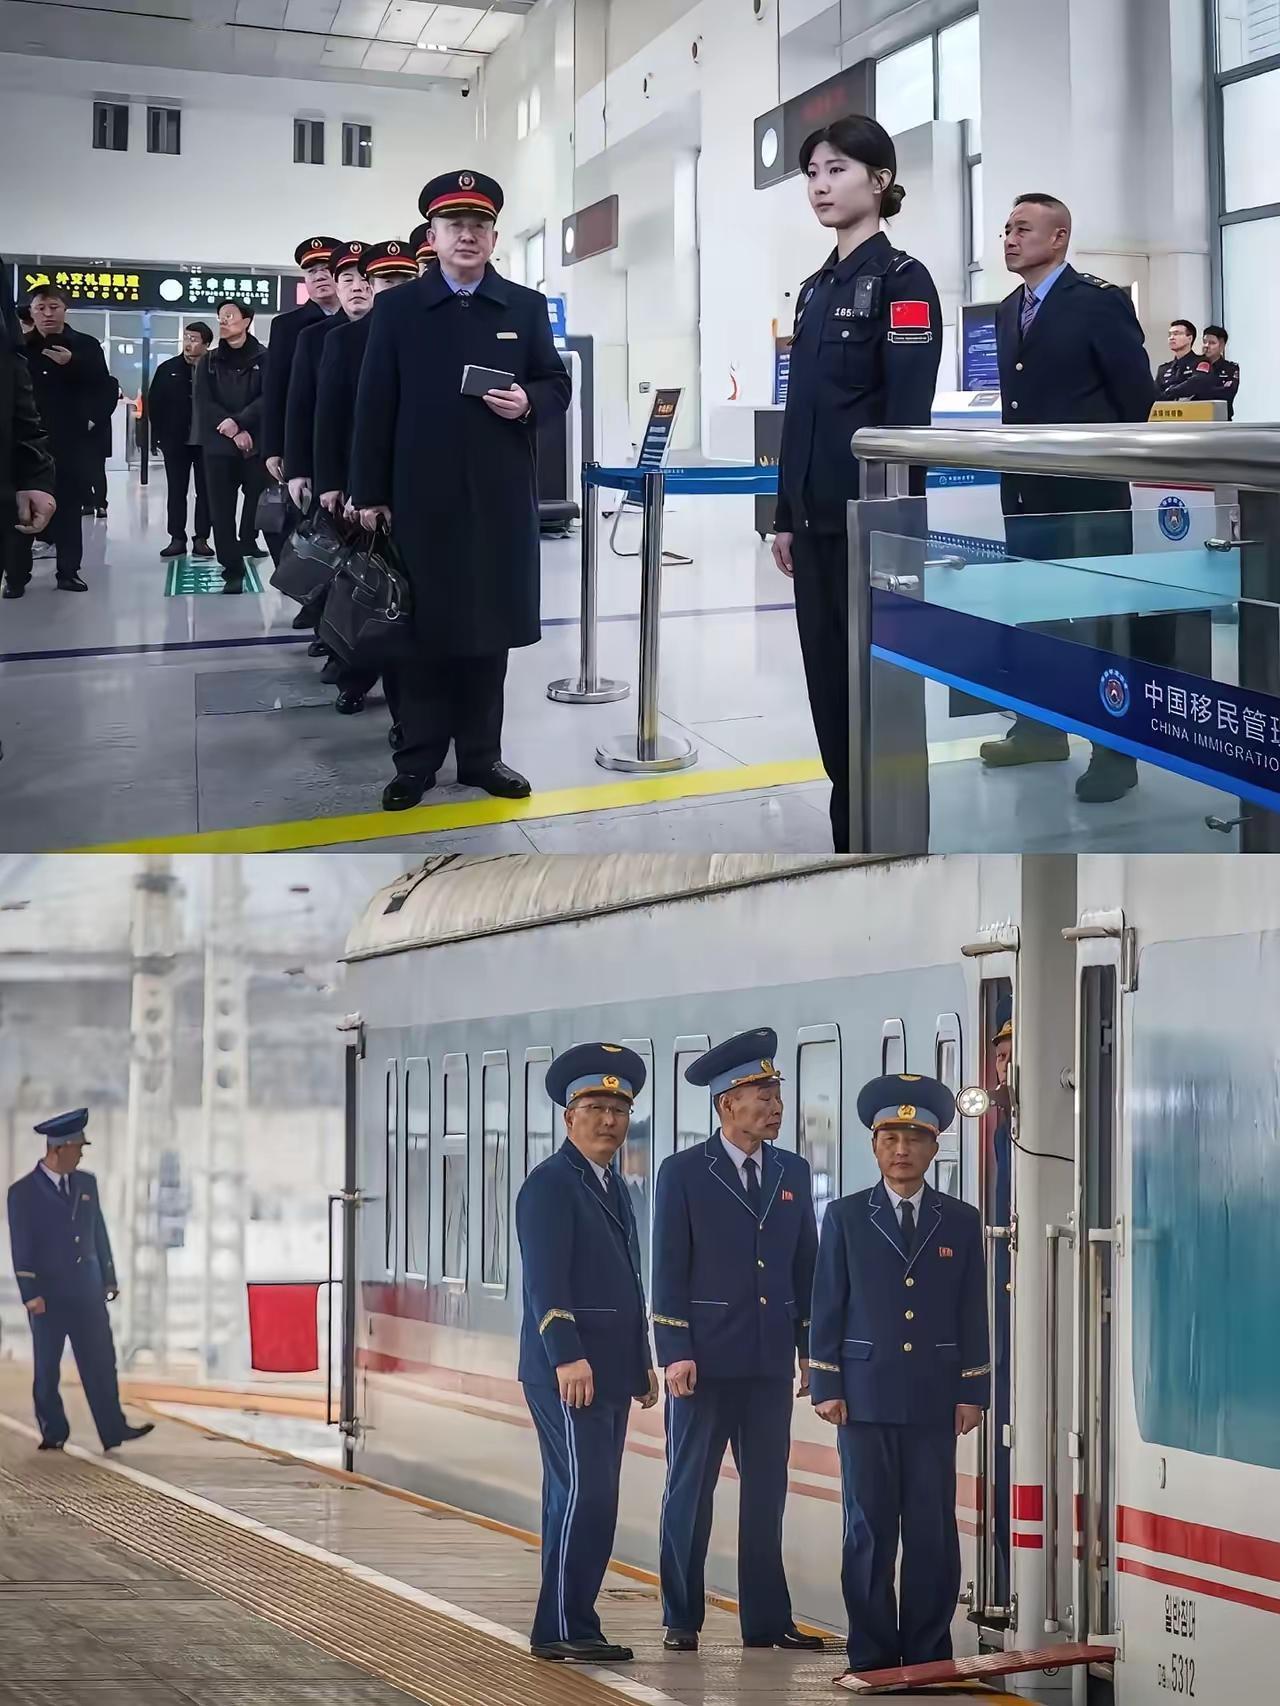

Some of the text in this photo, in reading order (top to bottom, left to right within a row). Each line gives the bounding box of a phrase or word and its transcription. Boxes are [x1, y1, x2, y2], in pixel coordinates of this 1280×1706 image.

[1151, 718, 1280, 771] CHINA IMMIGRATIO
[1172, 1653, 1195, 1697] 5312
